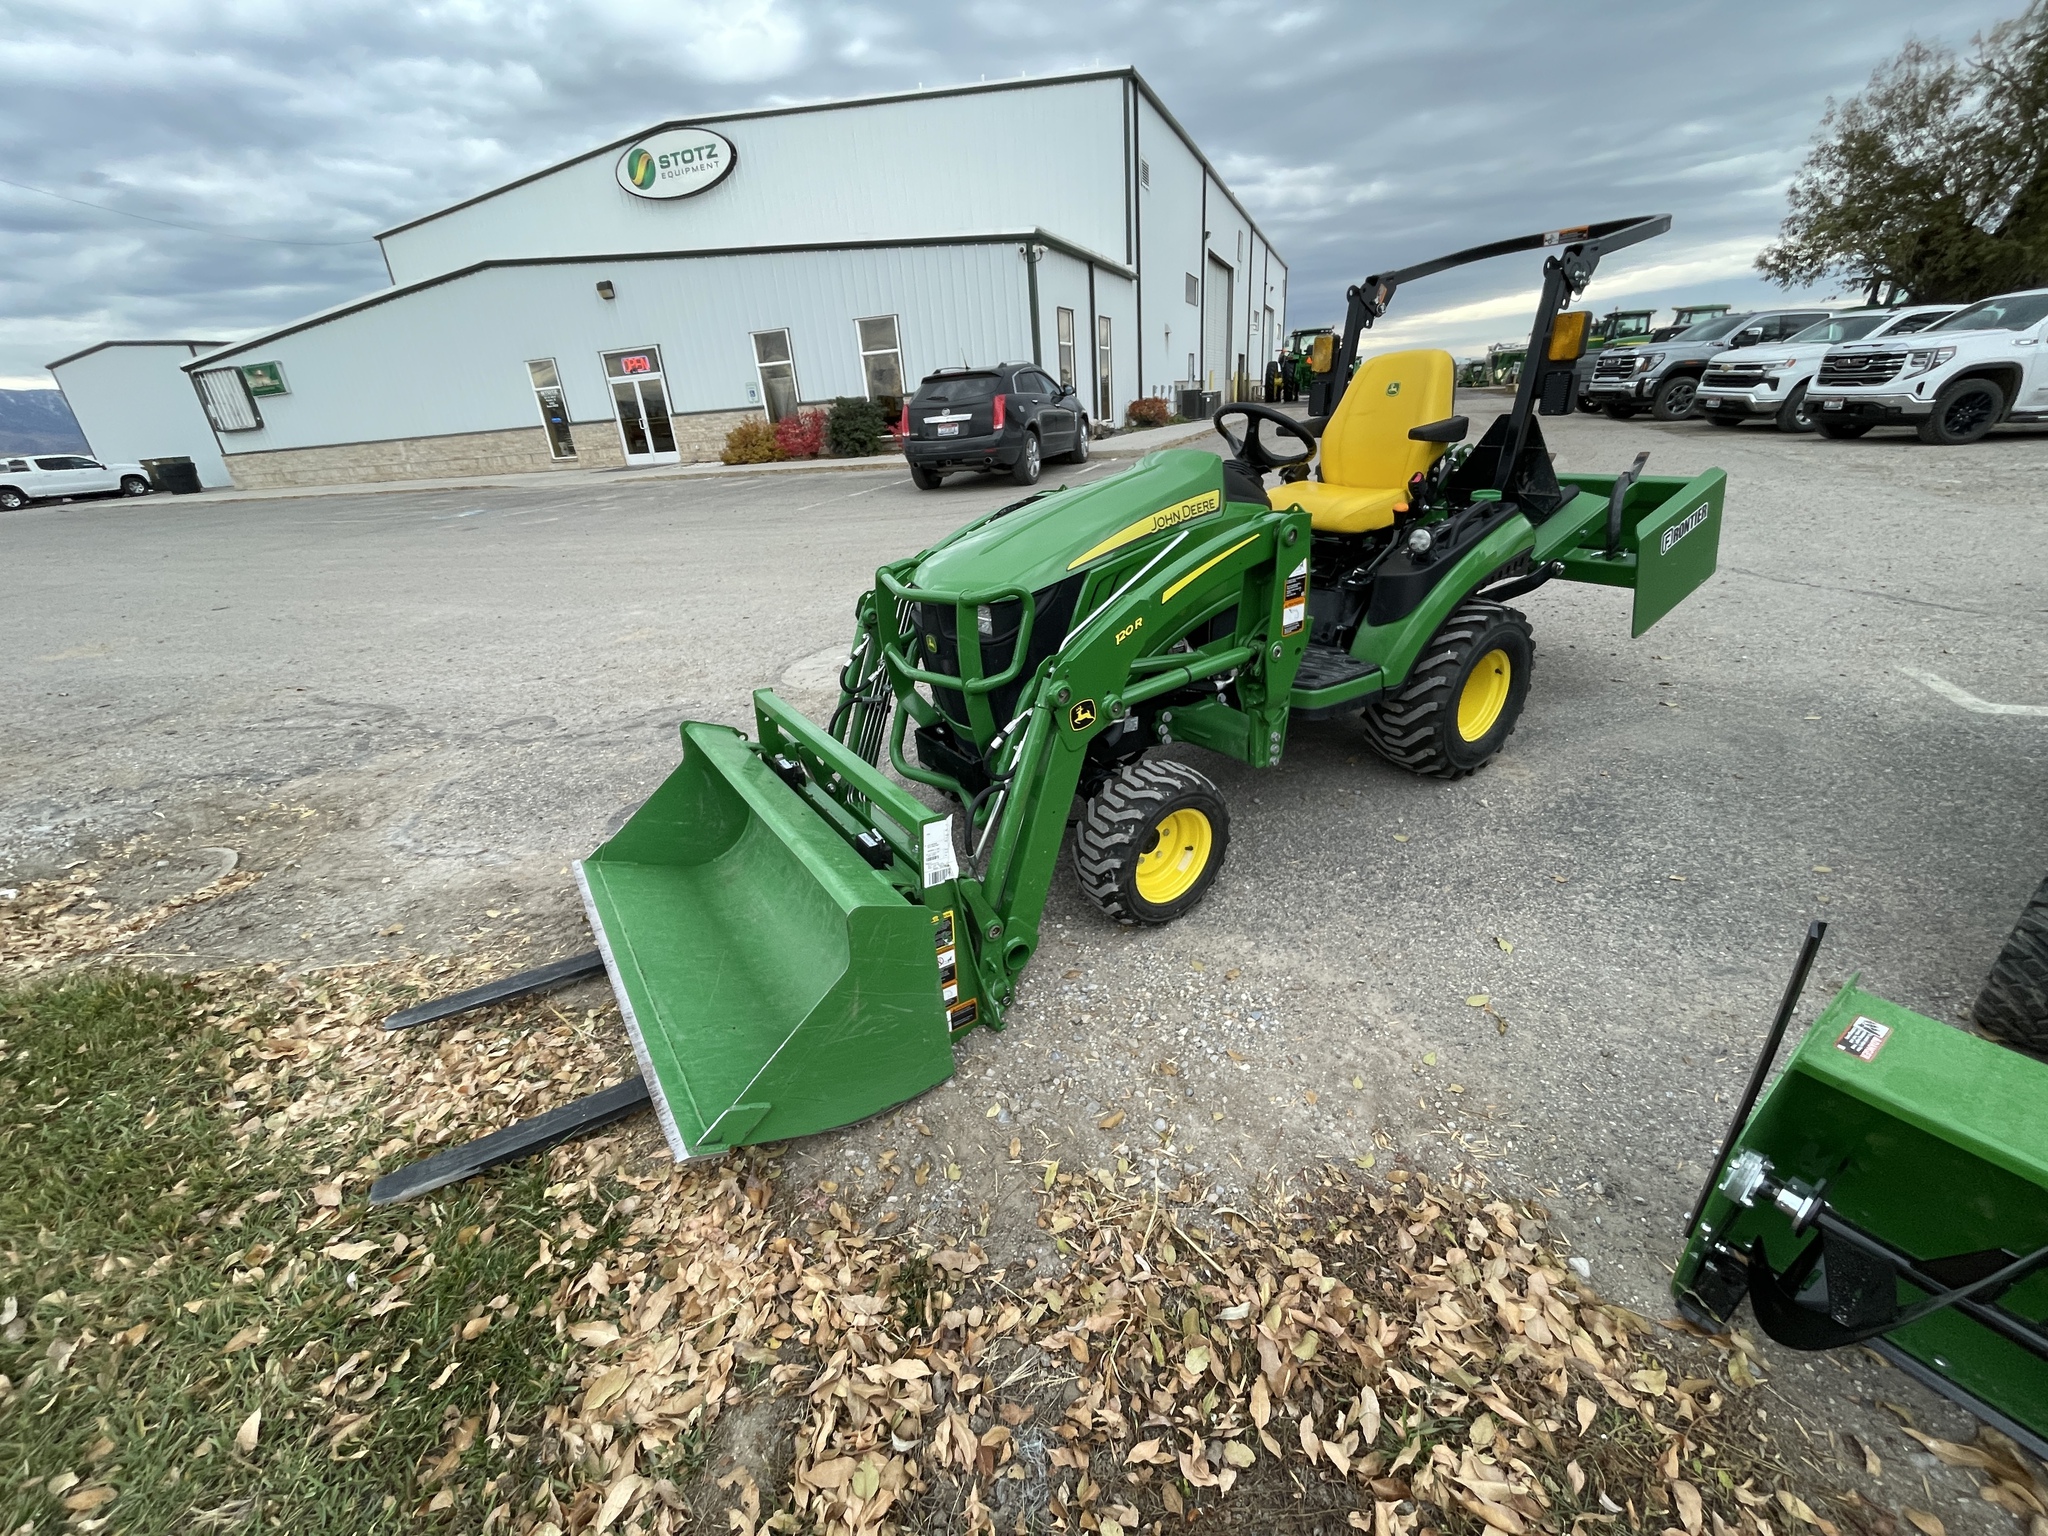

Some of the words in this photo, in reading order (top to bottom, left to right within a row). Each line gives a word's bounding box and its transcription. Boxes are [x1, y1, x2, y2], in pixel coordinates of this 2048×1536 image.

[658, 143, 719, 170] STOTZ
[661, 160, 721, 180] EQUIPMENT
[623, 356, 649, 373] OPEN
[1151, 510, 1181, 531] JOHN
[1182, 498, 1216, 518] DEERE
[1661, 502, 1709, 555] FRONTIER
